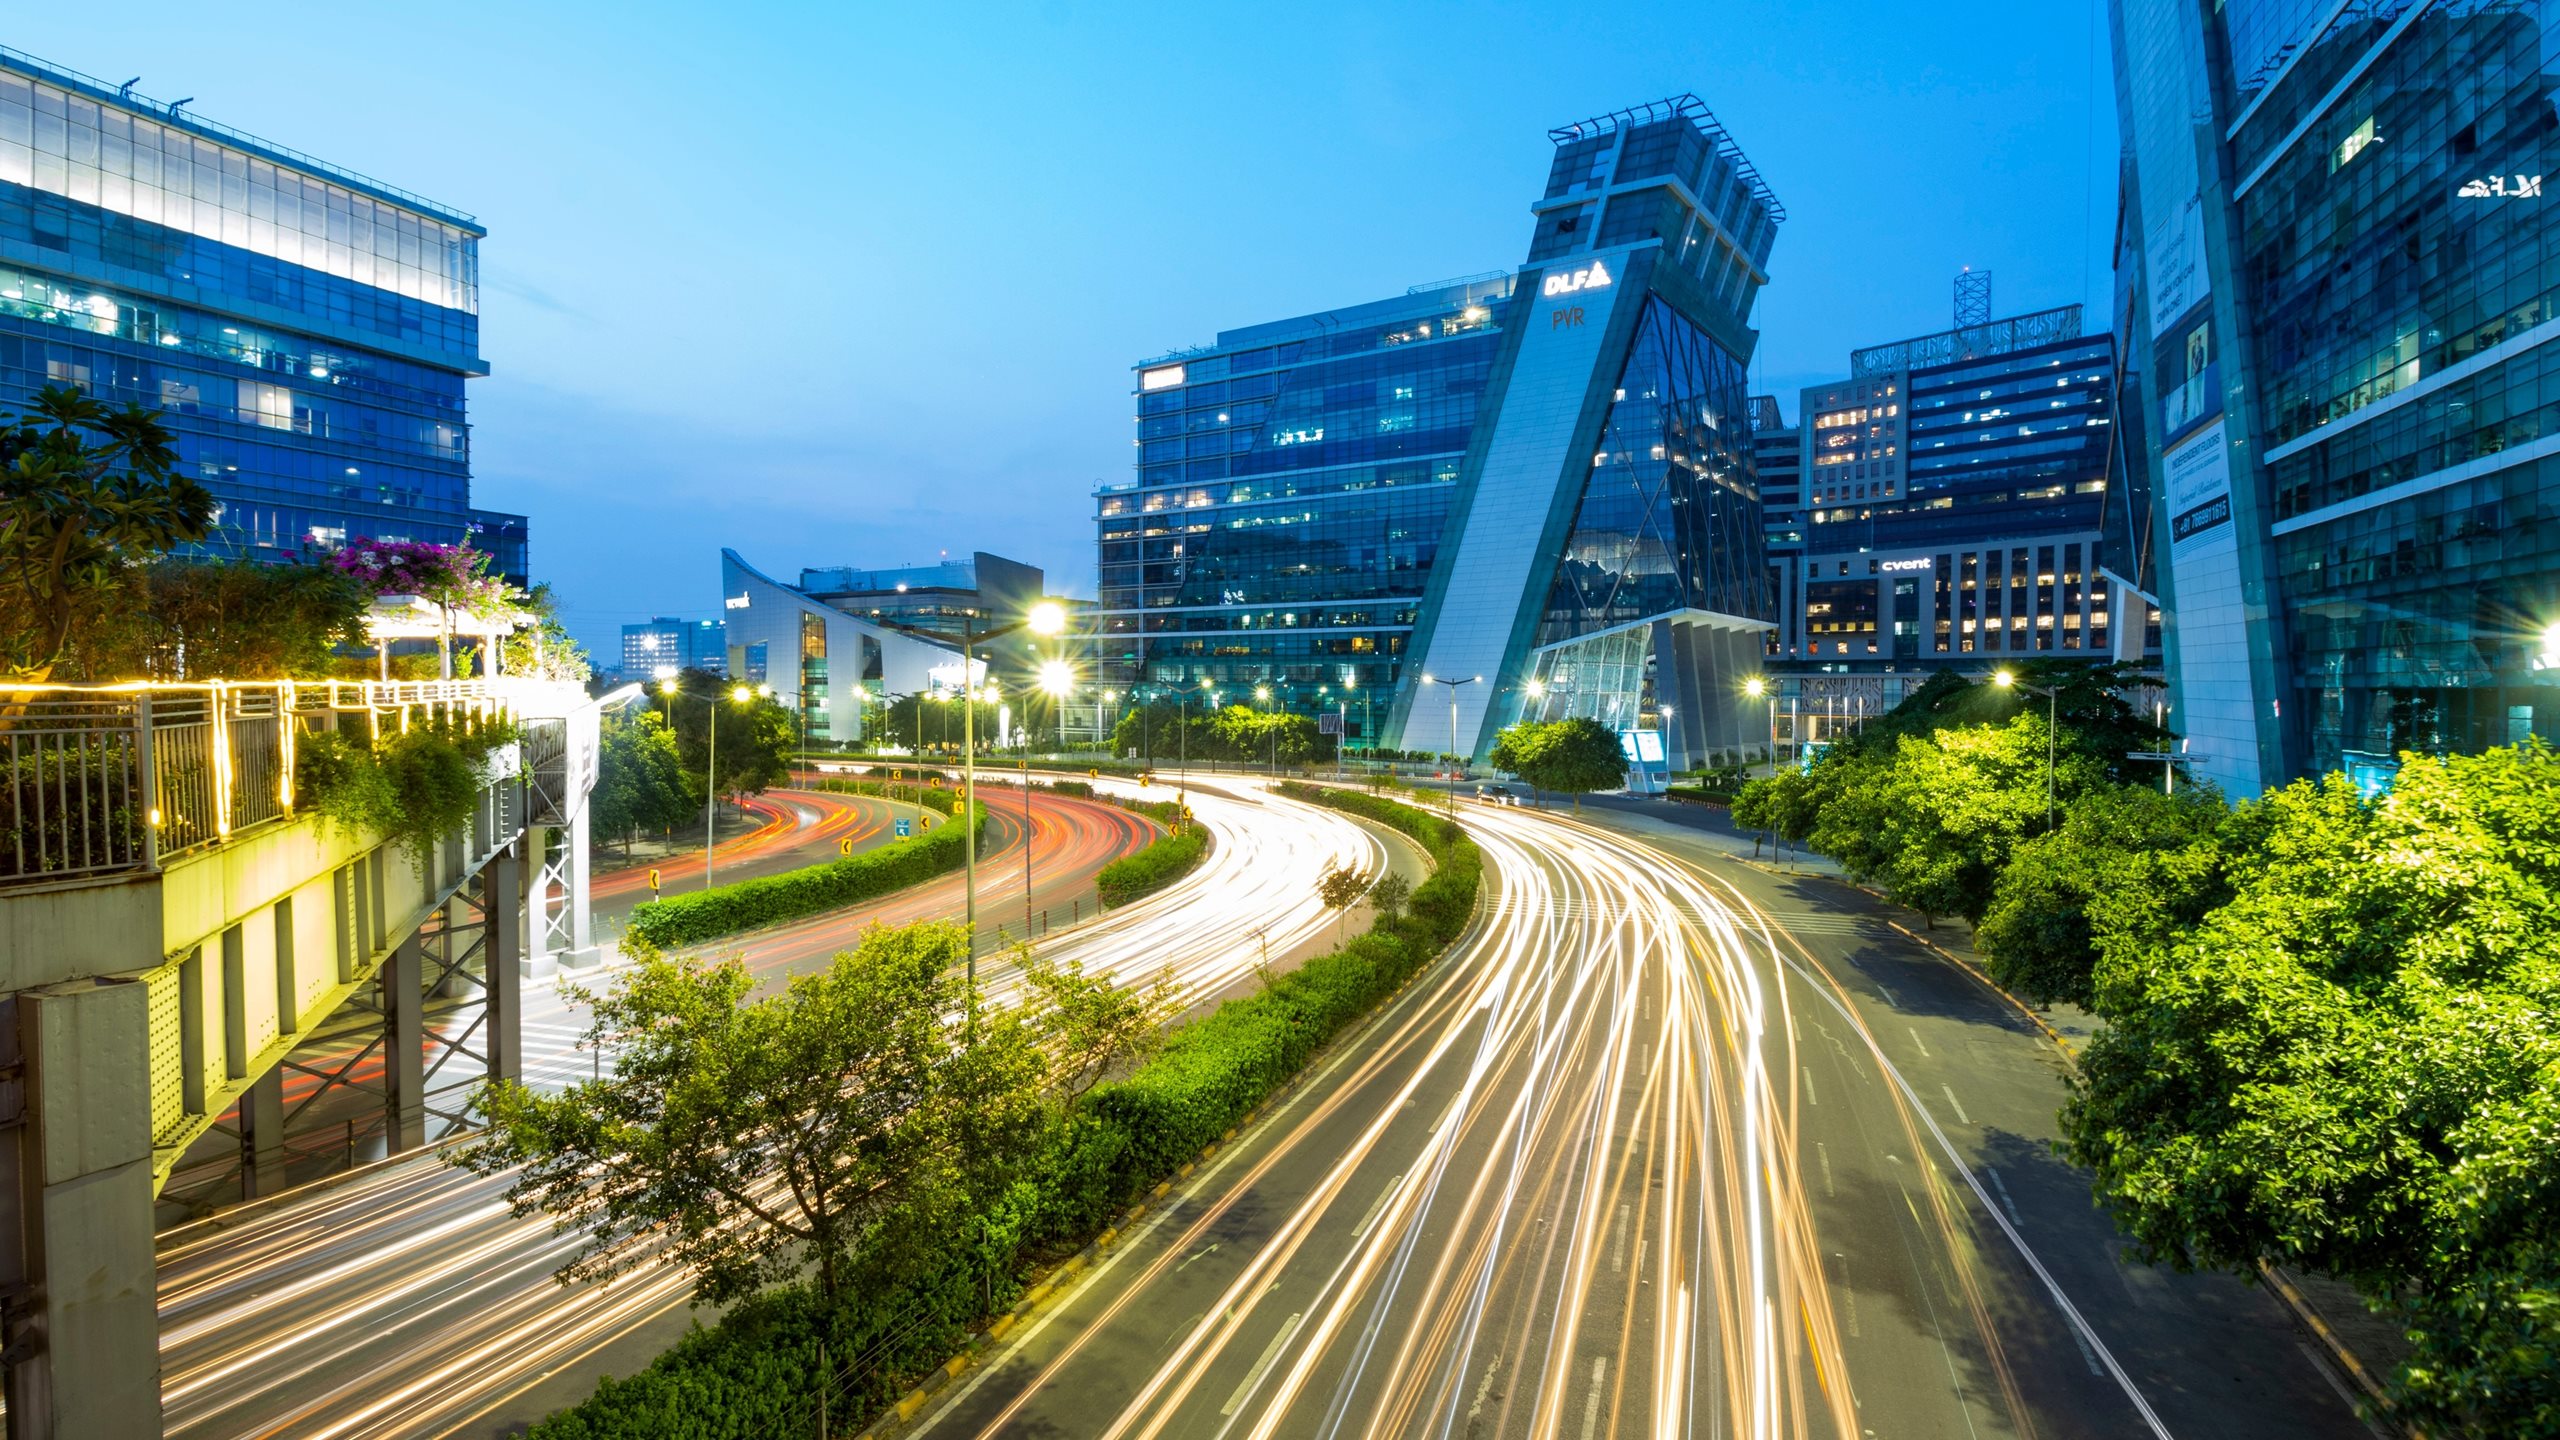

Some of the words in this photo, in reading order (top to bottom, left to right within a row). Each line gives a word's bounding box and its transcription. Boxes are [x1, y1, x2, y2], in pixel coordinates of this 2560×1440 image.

[1544, 270, 1588, 296] DLF
[2158, 284, 2172, 304] WHEN
[2183, 262, 2195, 280] CAN
[1552, 306, 1585, 330] PVR
[2157, 306, 2170, 324] OWN
[2172, 442, 2200, 470] INDEPENDENT
[2200, 432, 2220, 452] FLOORS
[2180, 516, 2190, 534] +91
[1881, 557, 1931, 571] cvent
